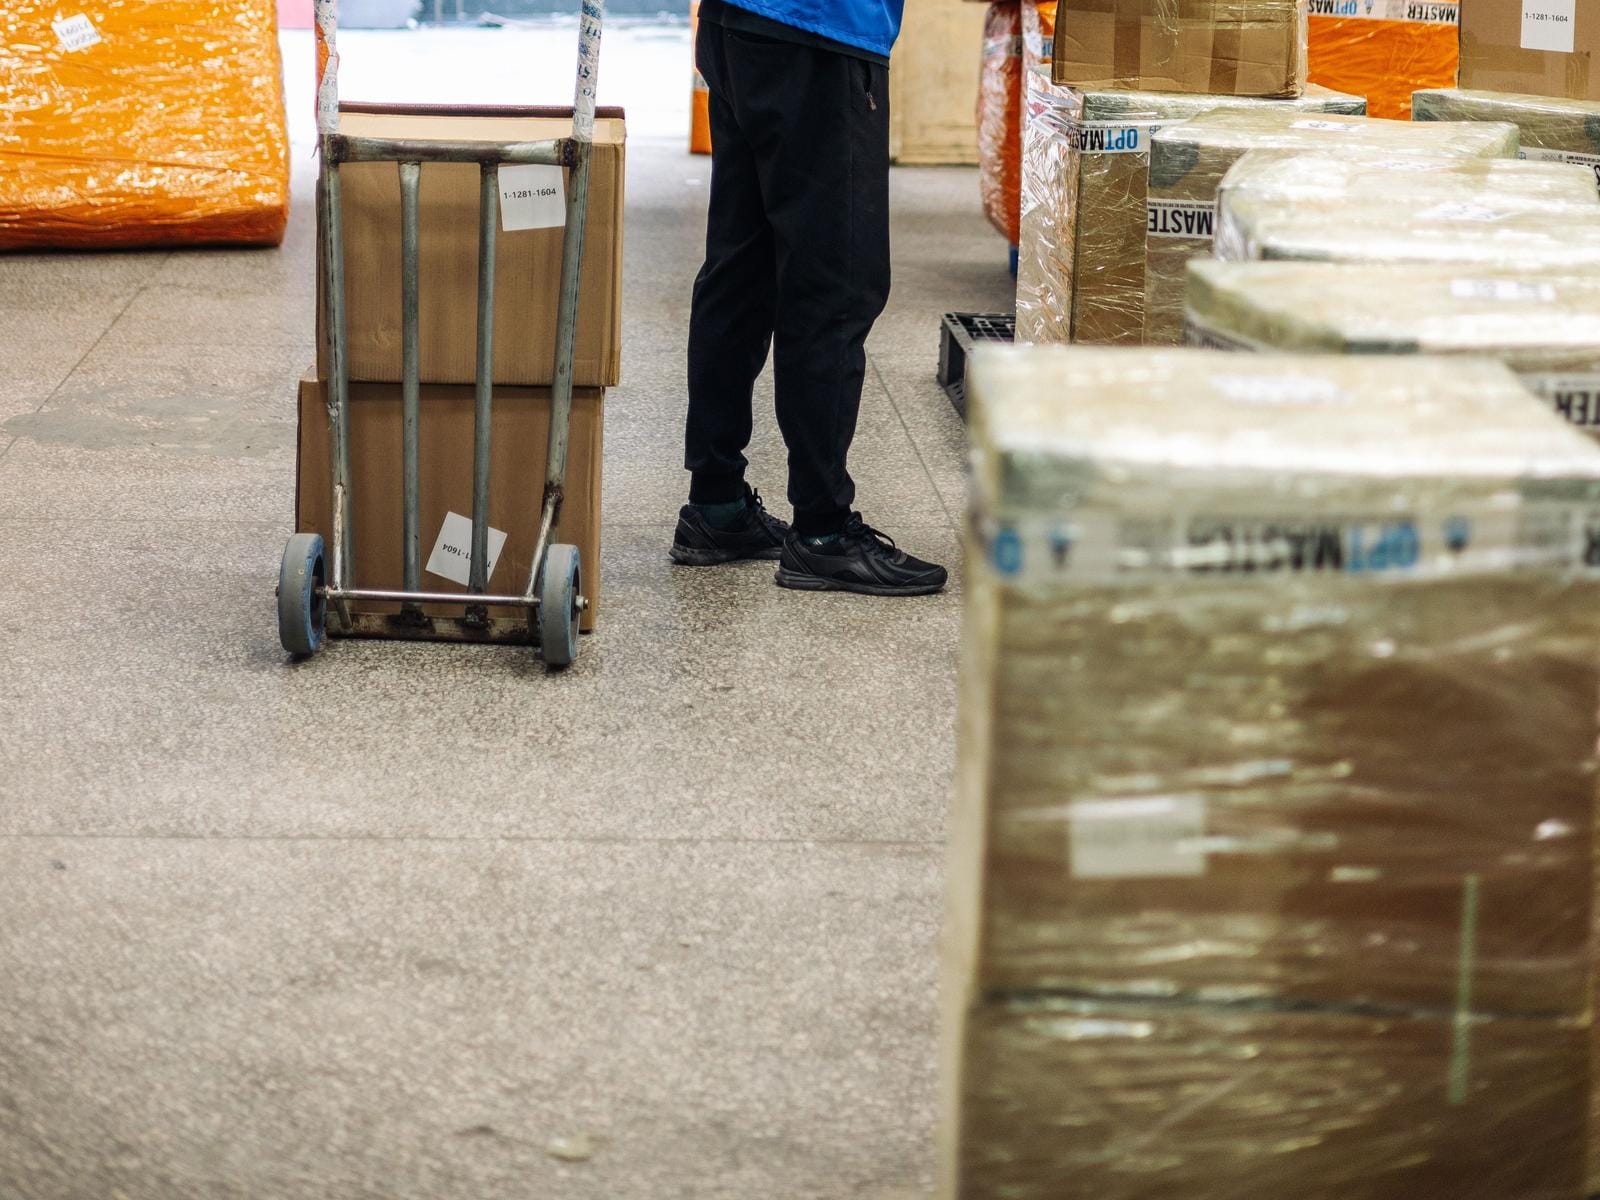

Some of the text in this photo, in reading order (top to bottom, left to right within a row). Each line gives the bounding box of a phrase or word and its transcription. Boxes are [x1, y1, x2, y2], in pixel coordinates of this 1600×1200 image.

[1407, 2, 1457, 22] MASTER
[1525, 12, 1569, 22] 1-1281-1604
[503, 187, 556, 200] 1-1281-1604
[1148, 208, 1214, 236] MASTE
